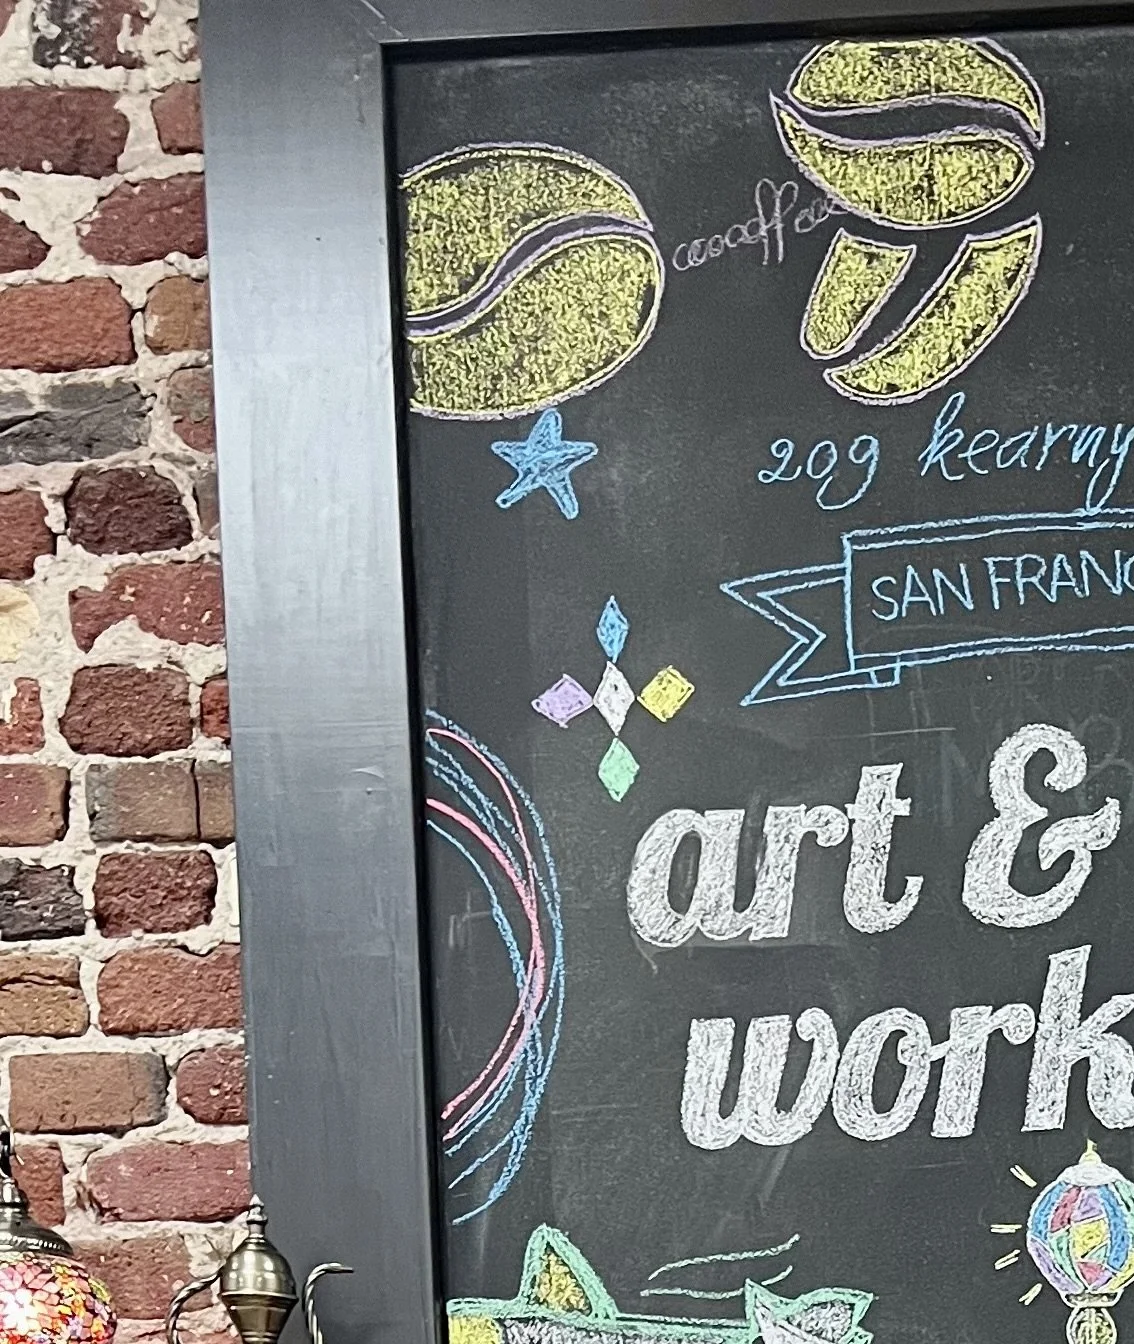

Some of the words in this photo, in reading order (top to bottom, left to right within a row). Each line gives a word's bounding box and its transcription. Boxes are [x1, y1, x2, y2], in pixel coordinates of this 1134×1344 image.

[758, 434, 879, 510] 209
[871, 562, 975, 621] SAN
[626, 761, 924, 948] art
[961, 723, 1121, 928] &
